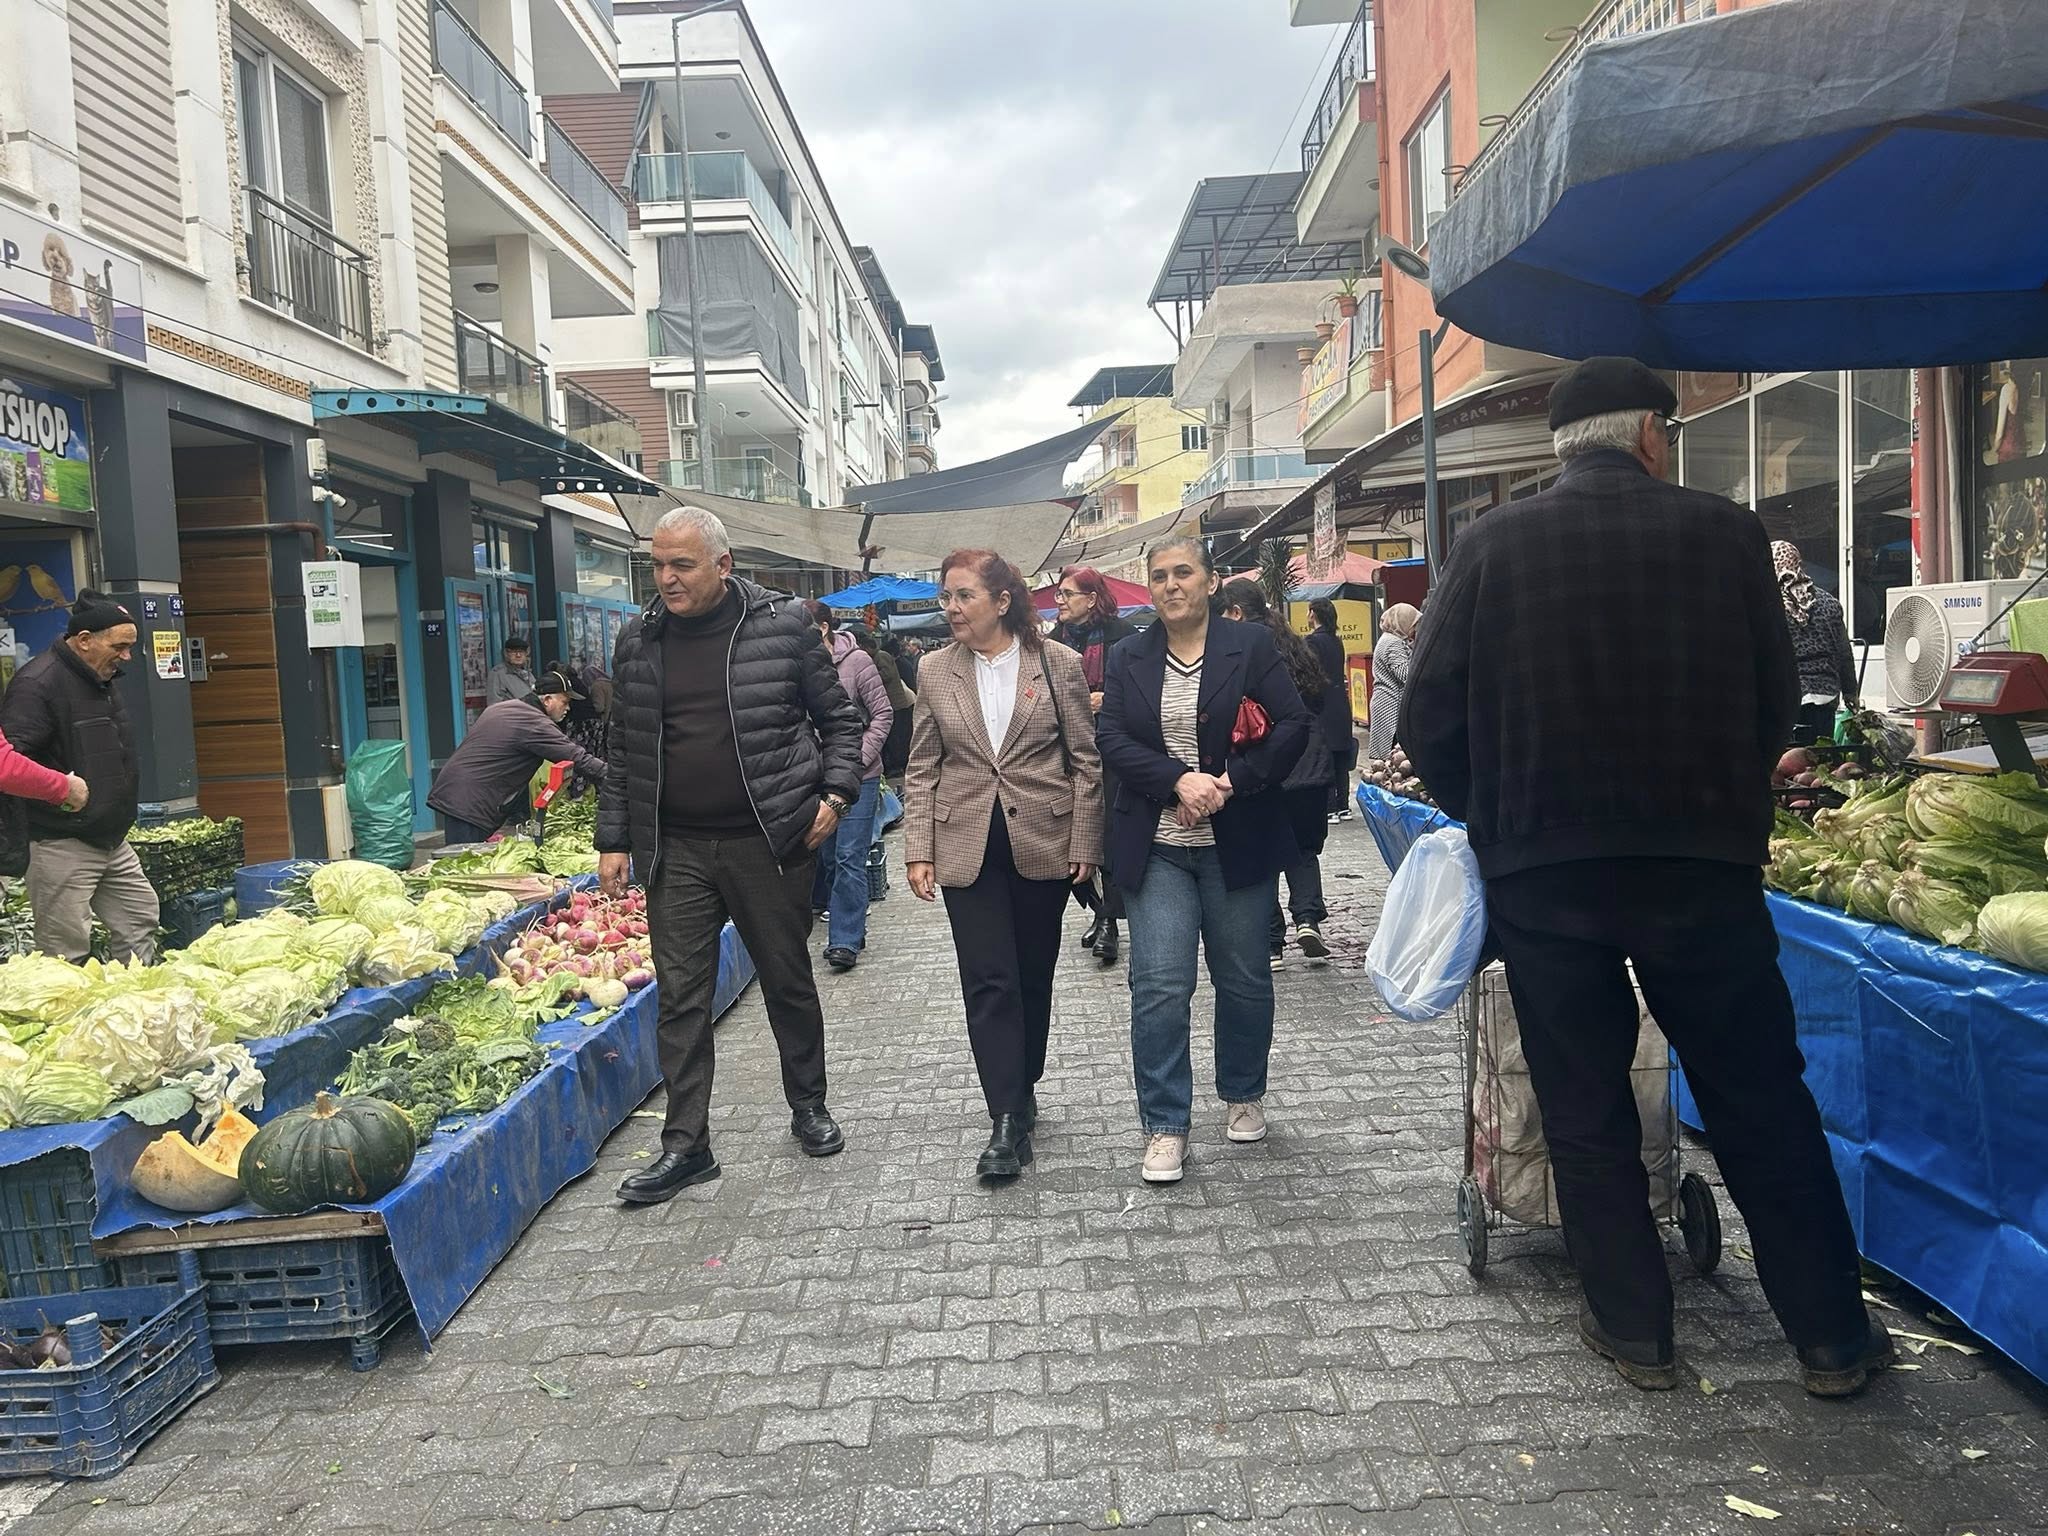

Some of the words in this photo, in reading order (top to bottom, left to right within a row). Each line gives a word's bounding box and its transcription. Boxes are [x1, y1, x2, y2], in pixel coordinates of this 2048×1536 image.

[0, 238, 20, 270] P
[1943, 596, 1982, 609] SAMSUNG
[1342, 624, 1358, 632] E.S.F
